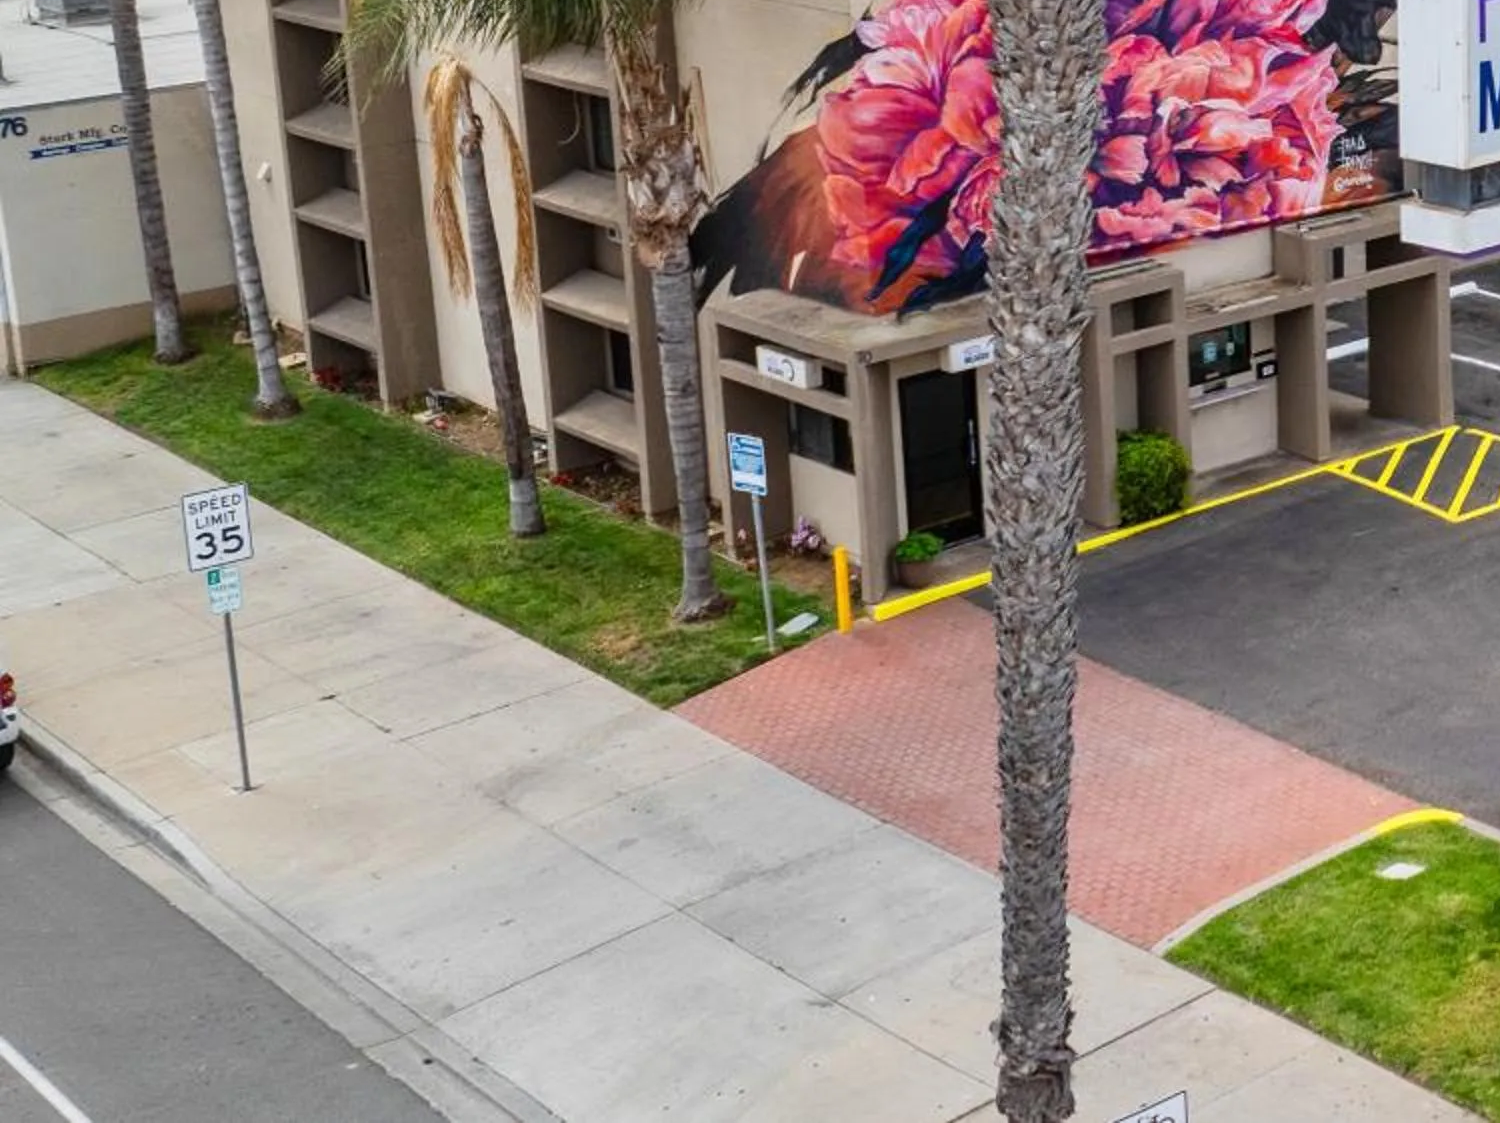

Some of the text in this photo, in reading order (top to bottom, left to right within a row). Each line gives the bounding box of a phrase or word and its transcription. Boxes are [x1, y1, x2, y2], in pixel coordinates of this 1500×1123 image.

[187, 493, 242, 516] SPEED
[194, 510, 237, 530] LIMIT
[194, 524, 245, 560] 35
